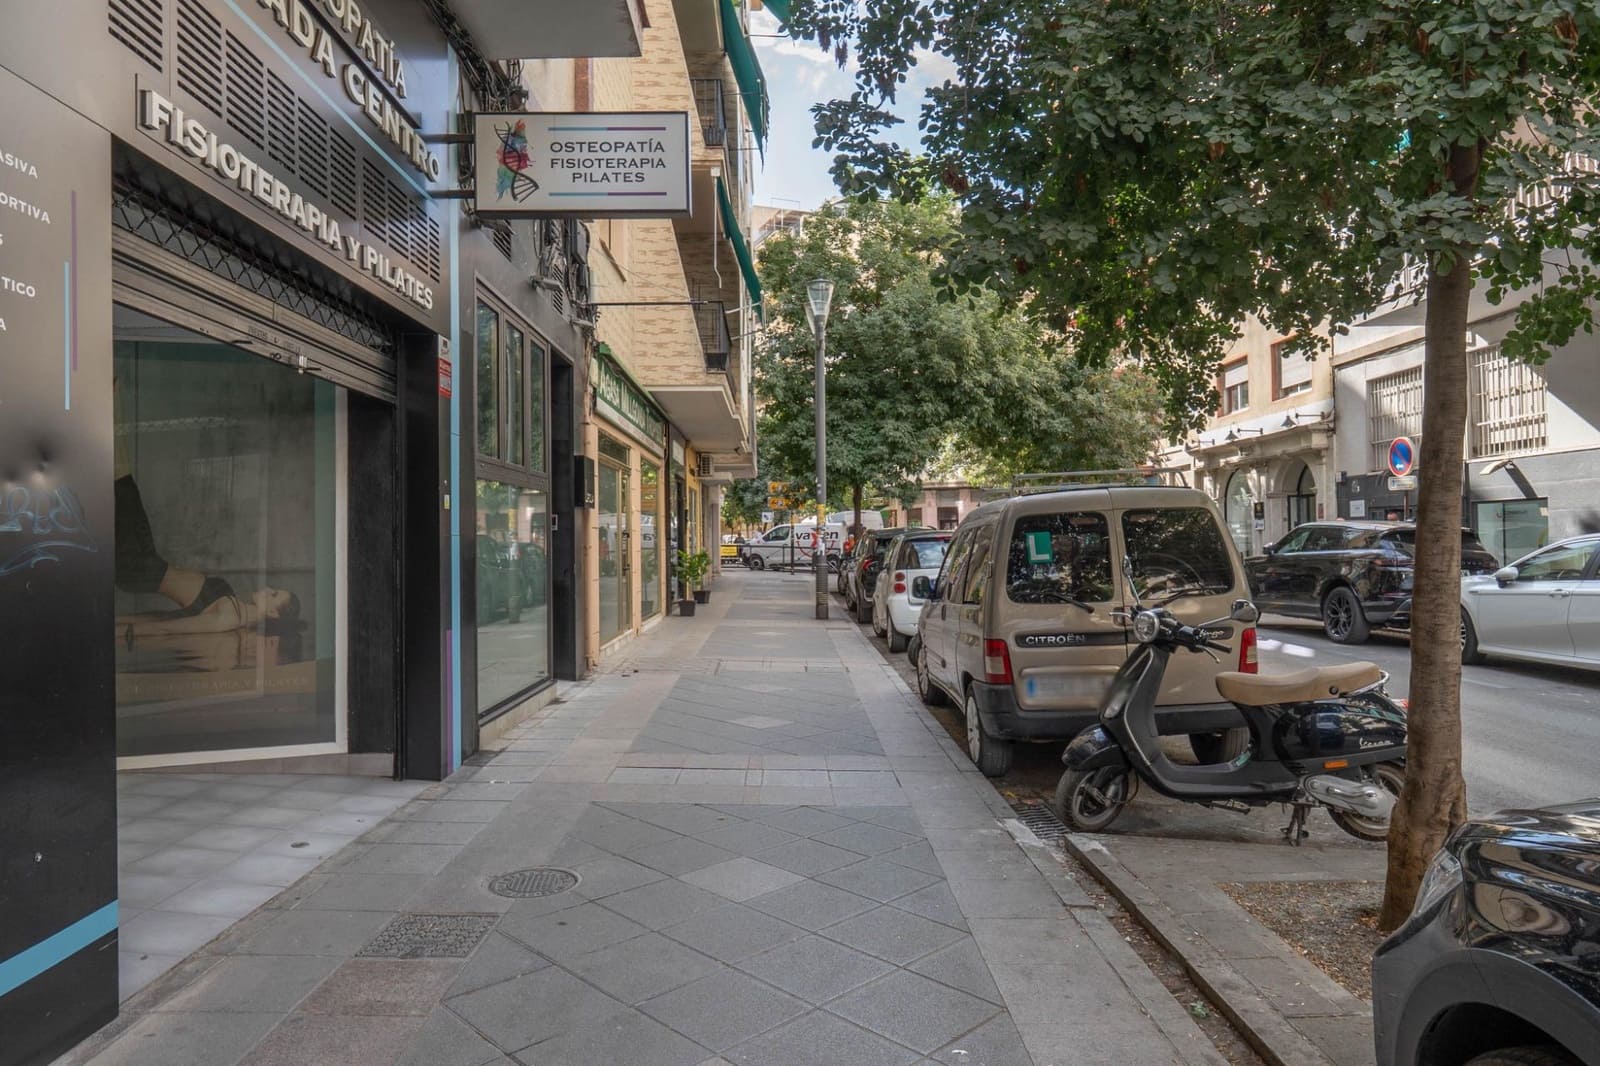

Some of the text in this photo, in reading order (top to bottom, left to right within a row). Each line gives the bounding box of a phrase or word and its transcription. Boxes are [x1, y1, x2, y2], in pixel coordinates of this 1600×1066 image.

[344, 63, 440, 183] CENTRO
[549, 138, 665, 154] OSTEOPATÍA
[549, 157, 667, 169] FISIOTERAPIA
[571, 172, 646, 183] PILATES
[143, 89, 433, 310] FISIOTERAPIA Y PILATES
[1, 276, 36, 297] TICO
[1028, 536, 1050, 561] L
[1025, 633, 1087, 645] CITROËN
